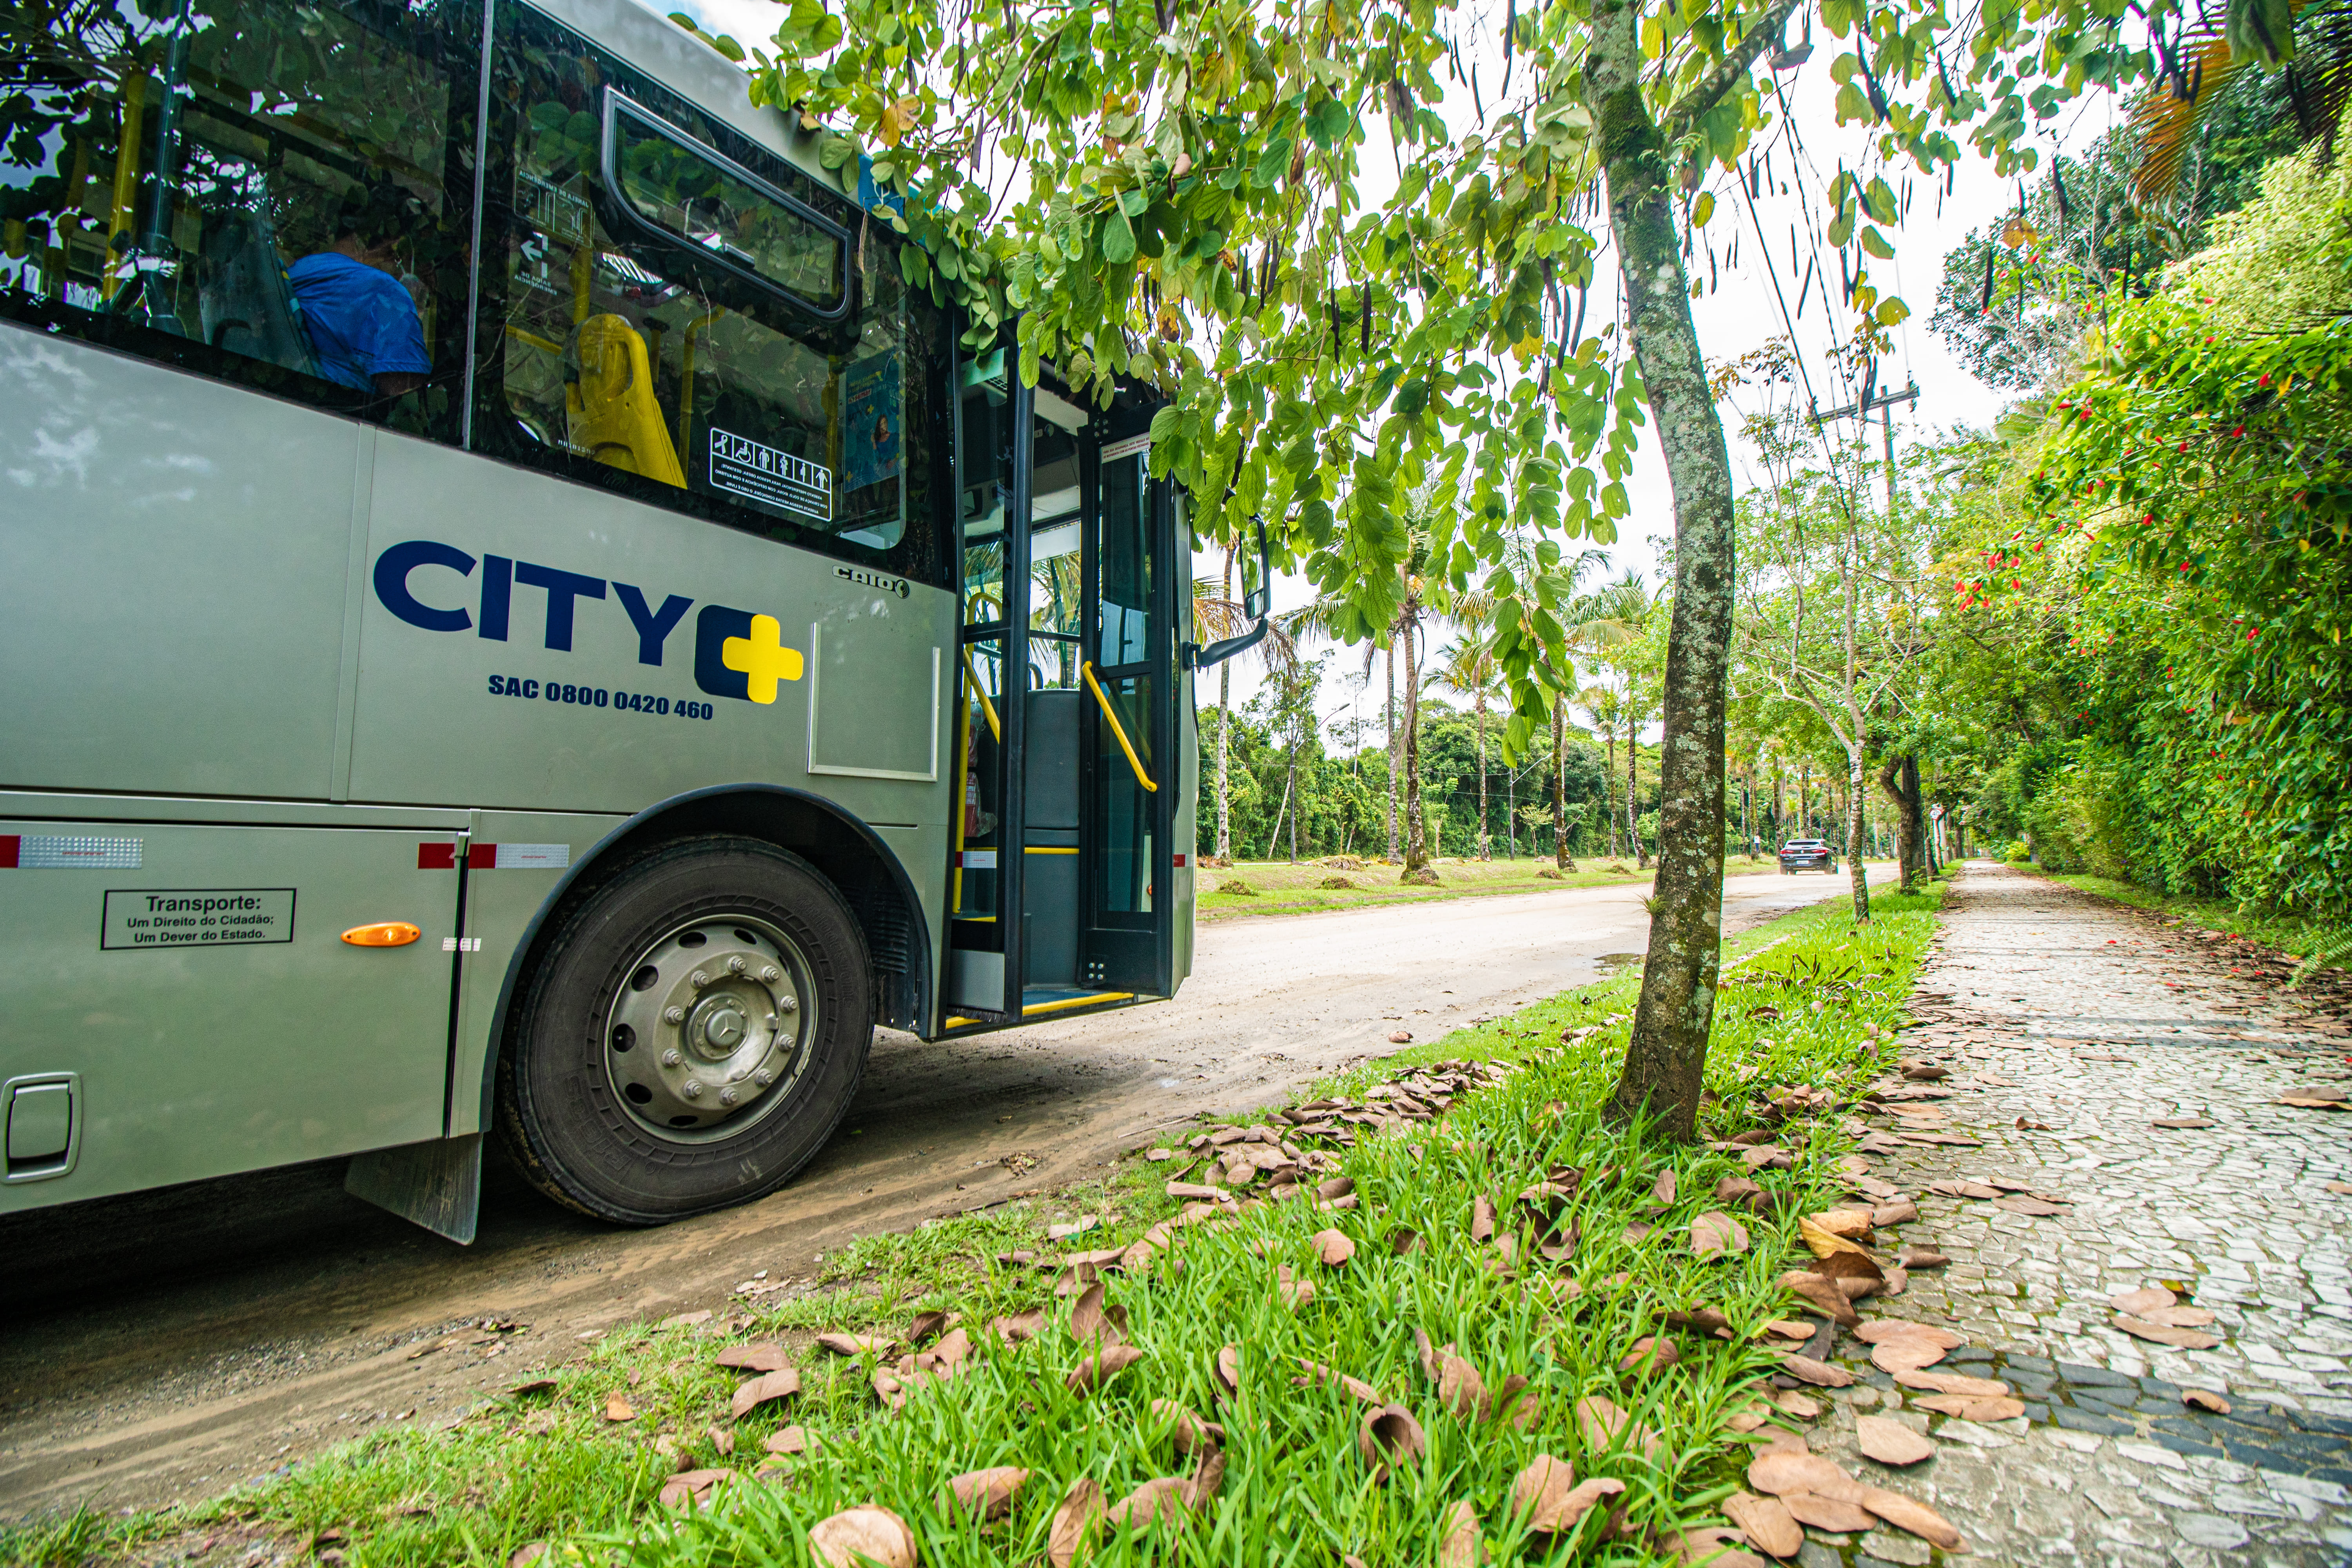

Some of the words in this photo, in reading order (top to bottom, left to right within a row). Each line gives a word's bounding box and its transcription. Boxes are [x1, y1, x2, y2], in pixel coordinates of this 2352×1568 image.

[832, 565, 893, 591] CAIO
[373, 540, 695, 666] CITY
[488, 674, 539, 699] SAC
[545, 682, 608, 707] 0800
[614, 691, 669, 715] 0420
[673, 700, 713, 720] 460
[146, 896, 261, 914] Transporte:
[128, 918, 149, 927] Um
[154, 916, 196, 927] Direito
[200, 916, 216, 926] do
[220, 914, 274, 926] Cidadão;
[134, 933, 155, 942] Um
[160, 932, 198, 942] Dever
[201, 931, 217, 940] do
[221, 930, 265, 939] Estado.
